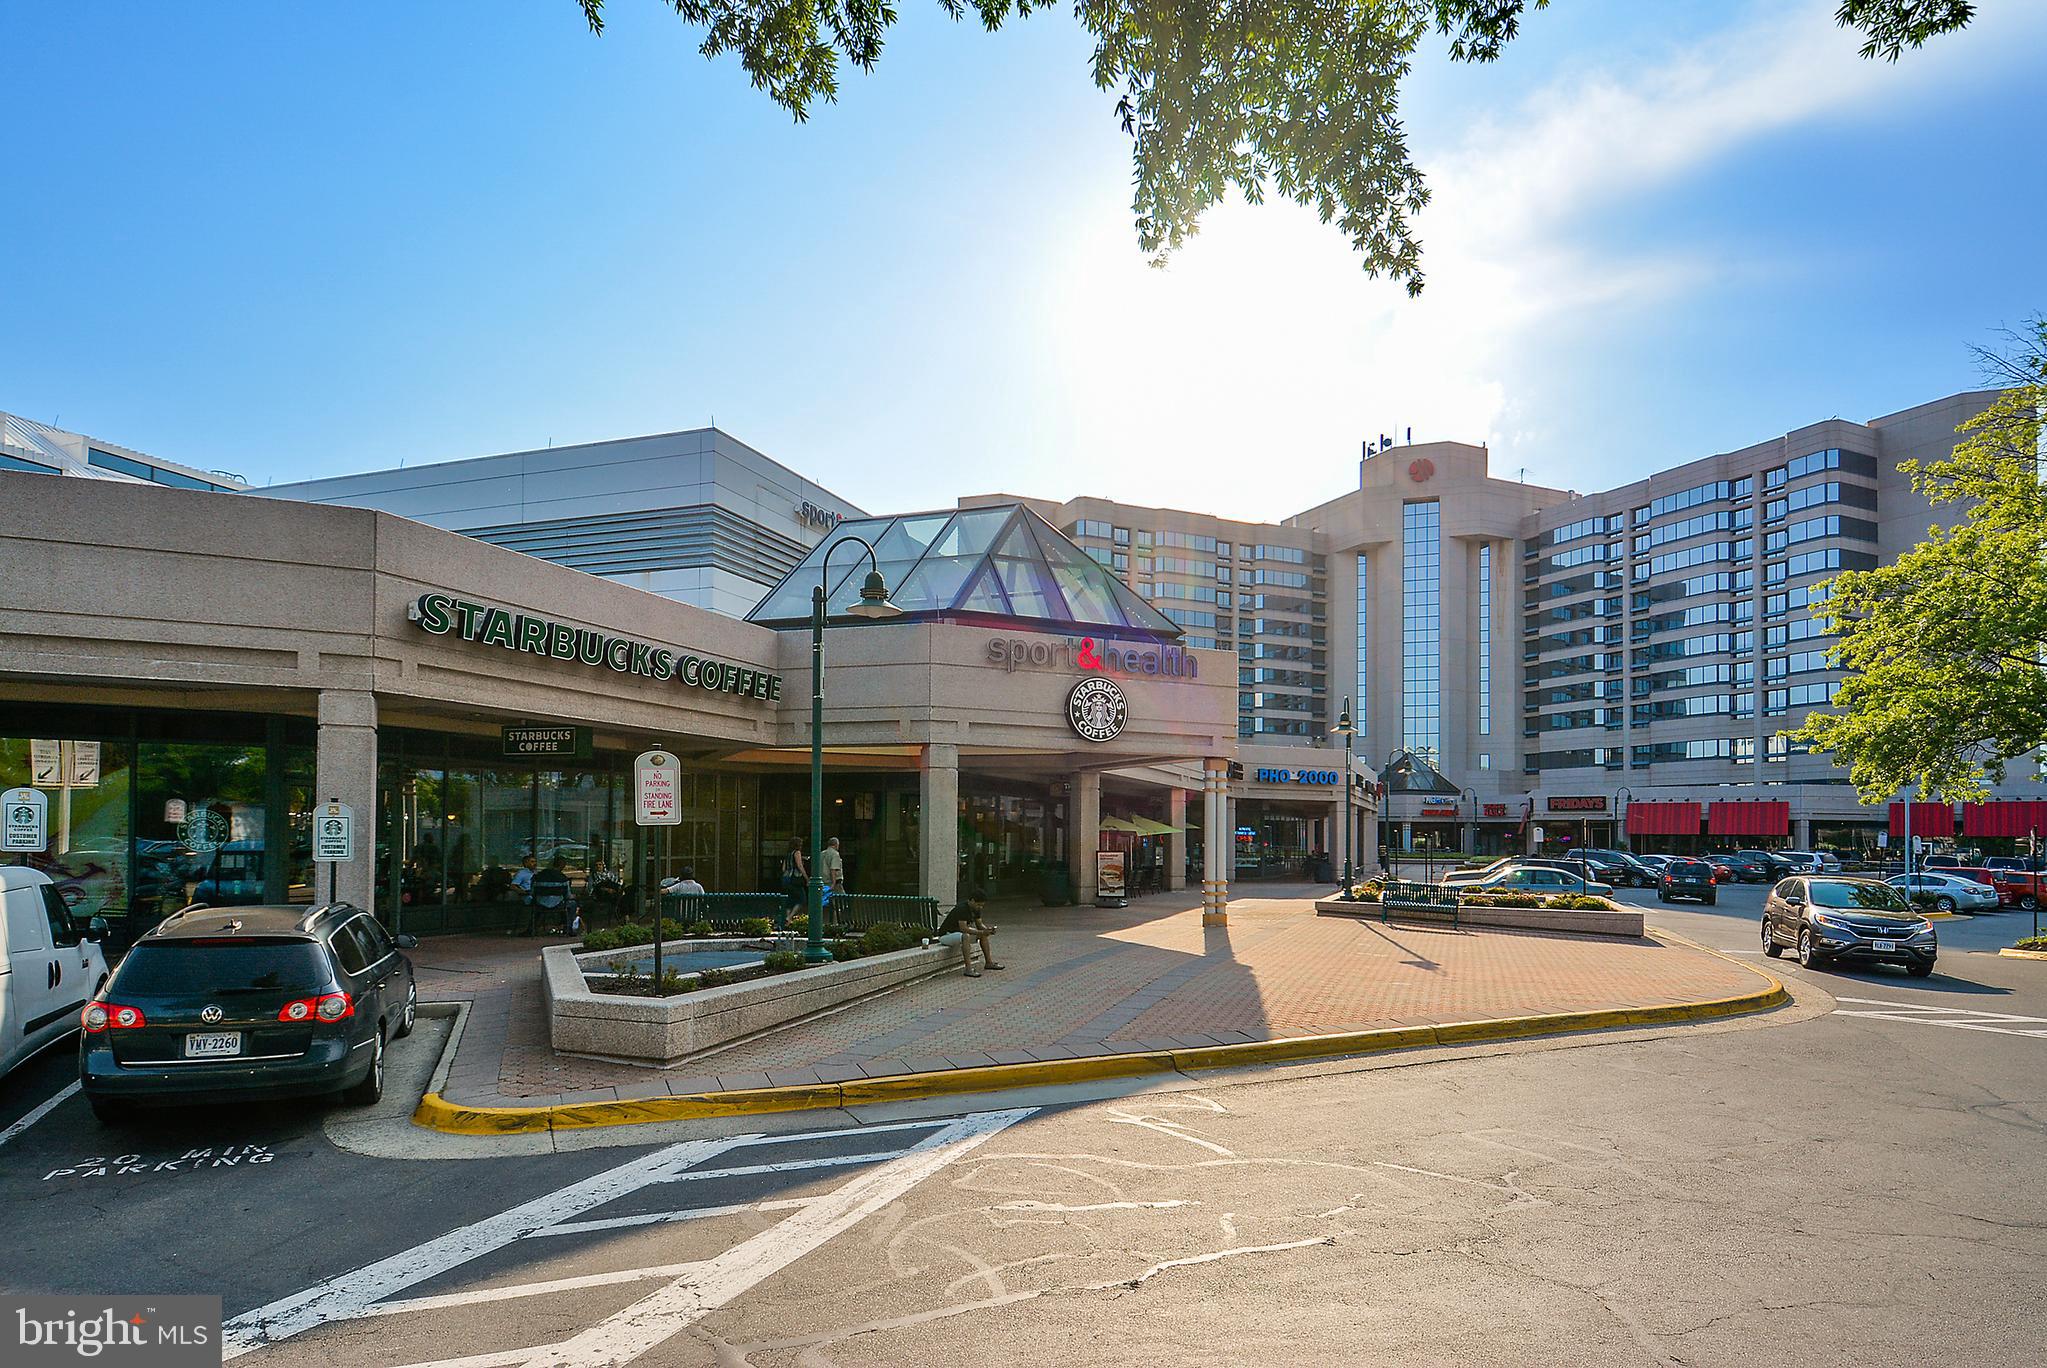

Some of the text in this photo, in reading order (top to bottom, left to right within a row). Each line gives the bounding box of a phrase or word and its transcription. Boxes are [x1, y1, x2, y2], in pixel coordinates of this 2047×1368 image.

[417, 592, 783, 702] STARBUCKS COFFEE
[1073, 680, 1125, 711] STARBUCKS
[508, 730, 571, 741] STARBUCKS
[1077, 719, 1119, 739] COFFEE
[518, 742, 558, 751] COFFEE
[1257, 768, 1291, 783] PHO
[1298, 769, 1339, 785] 2000
[180, 811, 227, 830] STARBUCKS
[42, 1153, 275, 1181] PARKING
